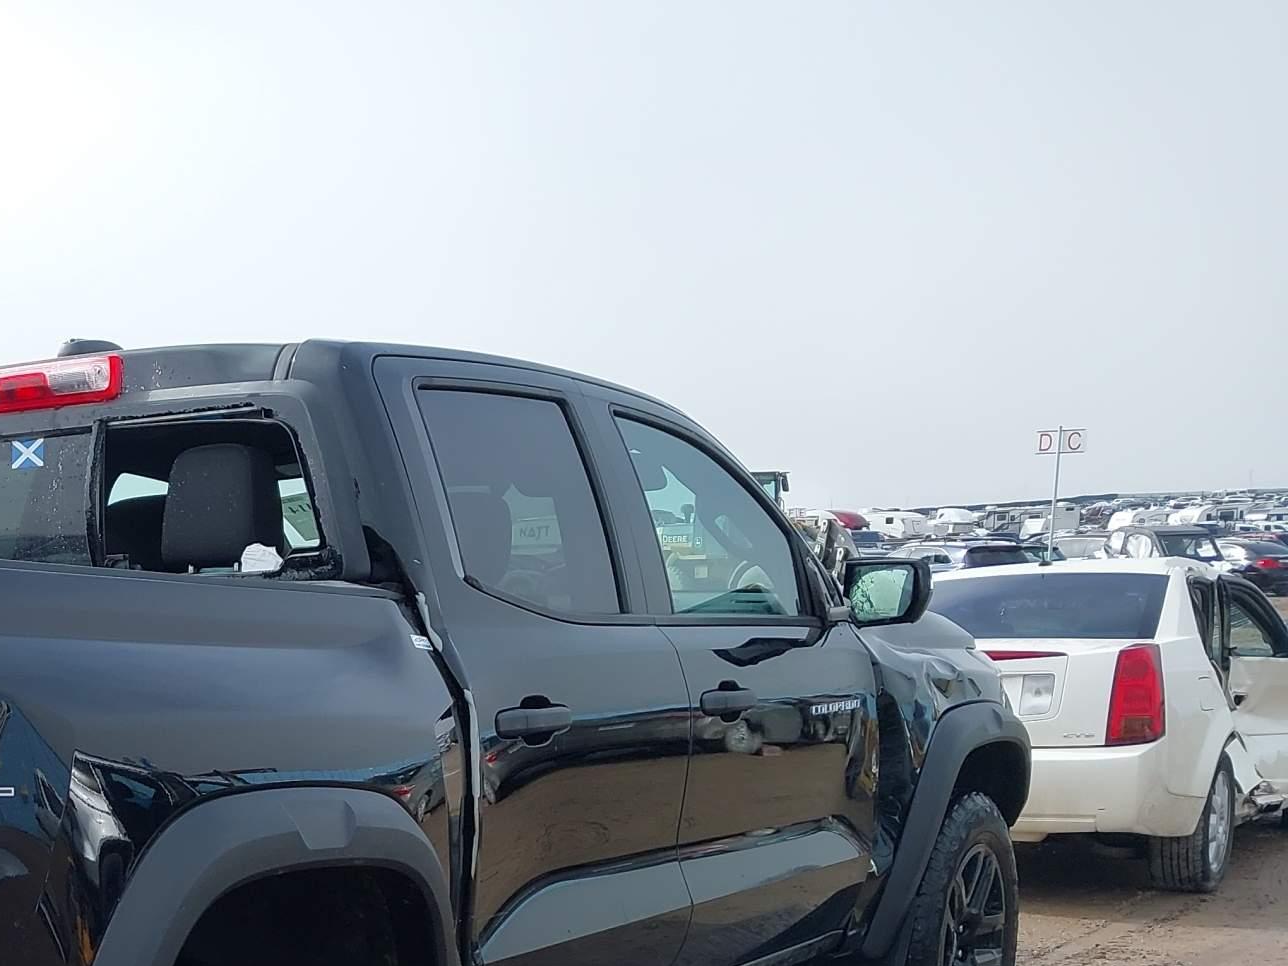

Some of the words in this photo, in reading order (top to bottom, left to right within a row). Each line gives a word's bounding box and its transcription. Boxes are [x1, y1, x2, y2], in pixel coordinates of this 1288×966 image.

[1039, 433, 1052, 451] D
[1068, 432, 1081, 450] C
[663, 535, 688, 543] DEERE
